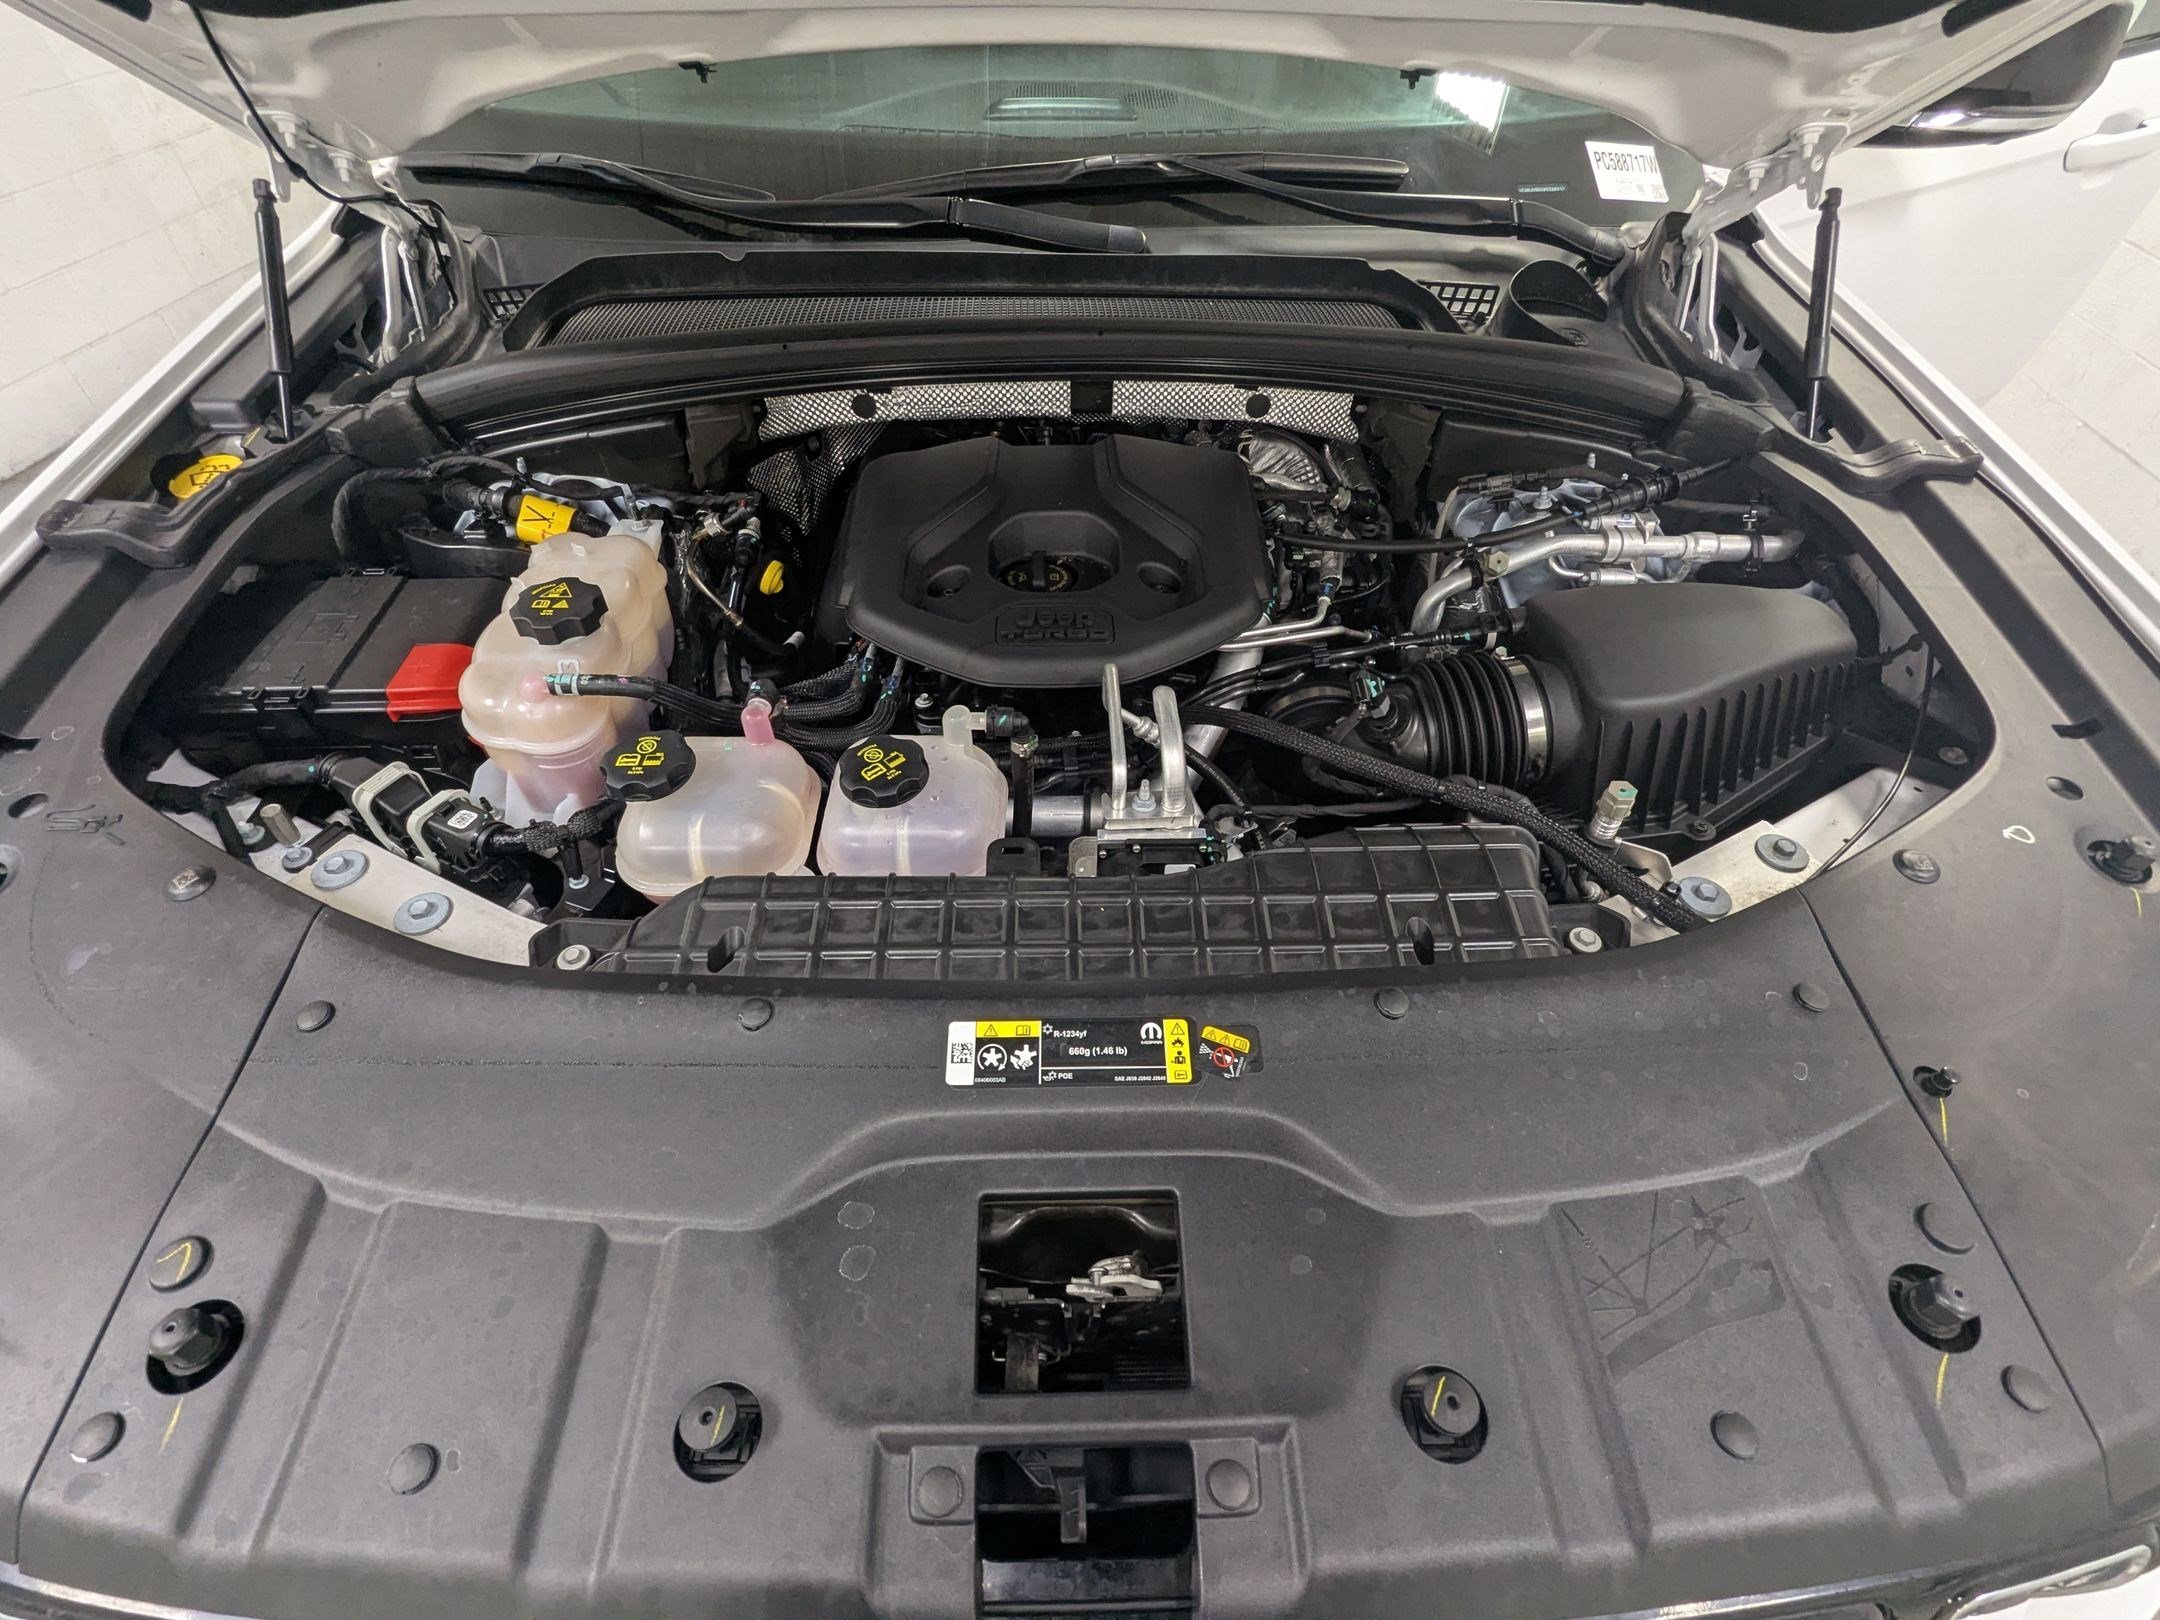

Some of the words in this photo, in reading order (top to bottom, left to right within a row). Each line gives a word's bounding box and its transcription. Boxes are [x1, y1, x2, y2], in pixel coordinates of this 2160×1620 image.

[1593, 151, 1658, 174] PC588717W
[1053, 1030, 1087, 1039] R-1234yf
[1068, 1046, 1090, 1057] 660g
[1092, 1046, 1114, 1057] (1.46
[1115, 1046, 1128, 1057] lb)
[1057, 1072, 1073, 1080] POE
